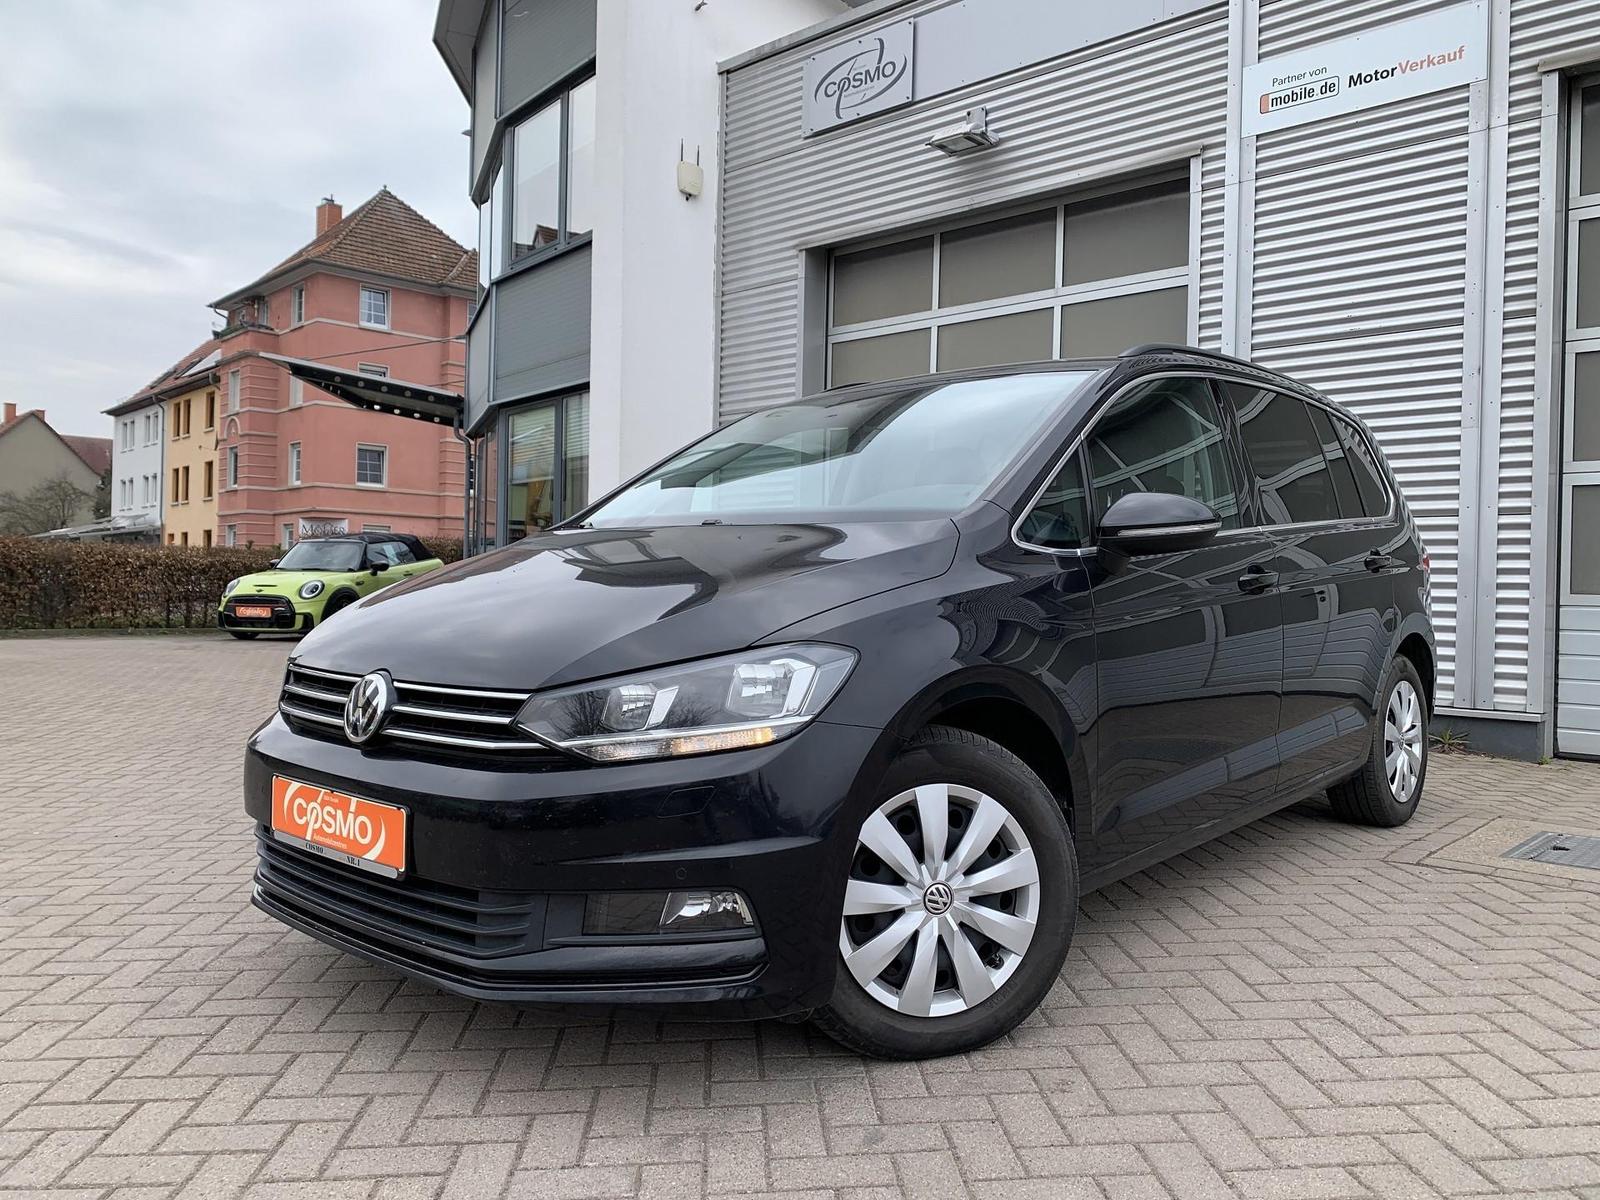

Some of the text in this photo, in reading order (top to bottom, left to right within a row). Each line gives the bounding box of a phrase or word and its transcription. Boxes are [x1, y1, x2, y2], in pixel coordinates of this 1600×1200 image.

[824, 61, 896, 98] COSMO
[1270, 45, 1466, 108] mobile.de MotorVerkauf
[1272, 66, 1328, 87] Partner von
[293, 797, 373, 845] COSMO
[305, 842, 324, 854] COSMO
